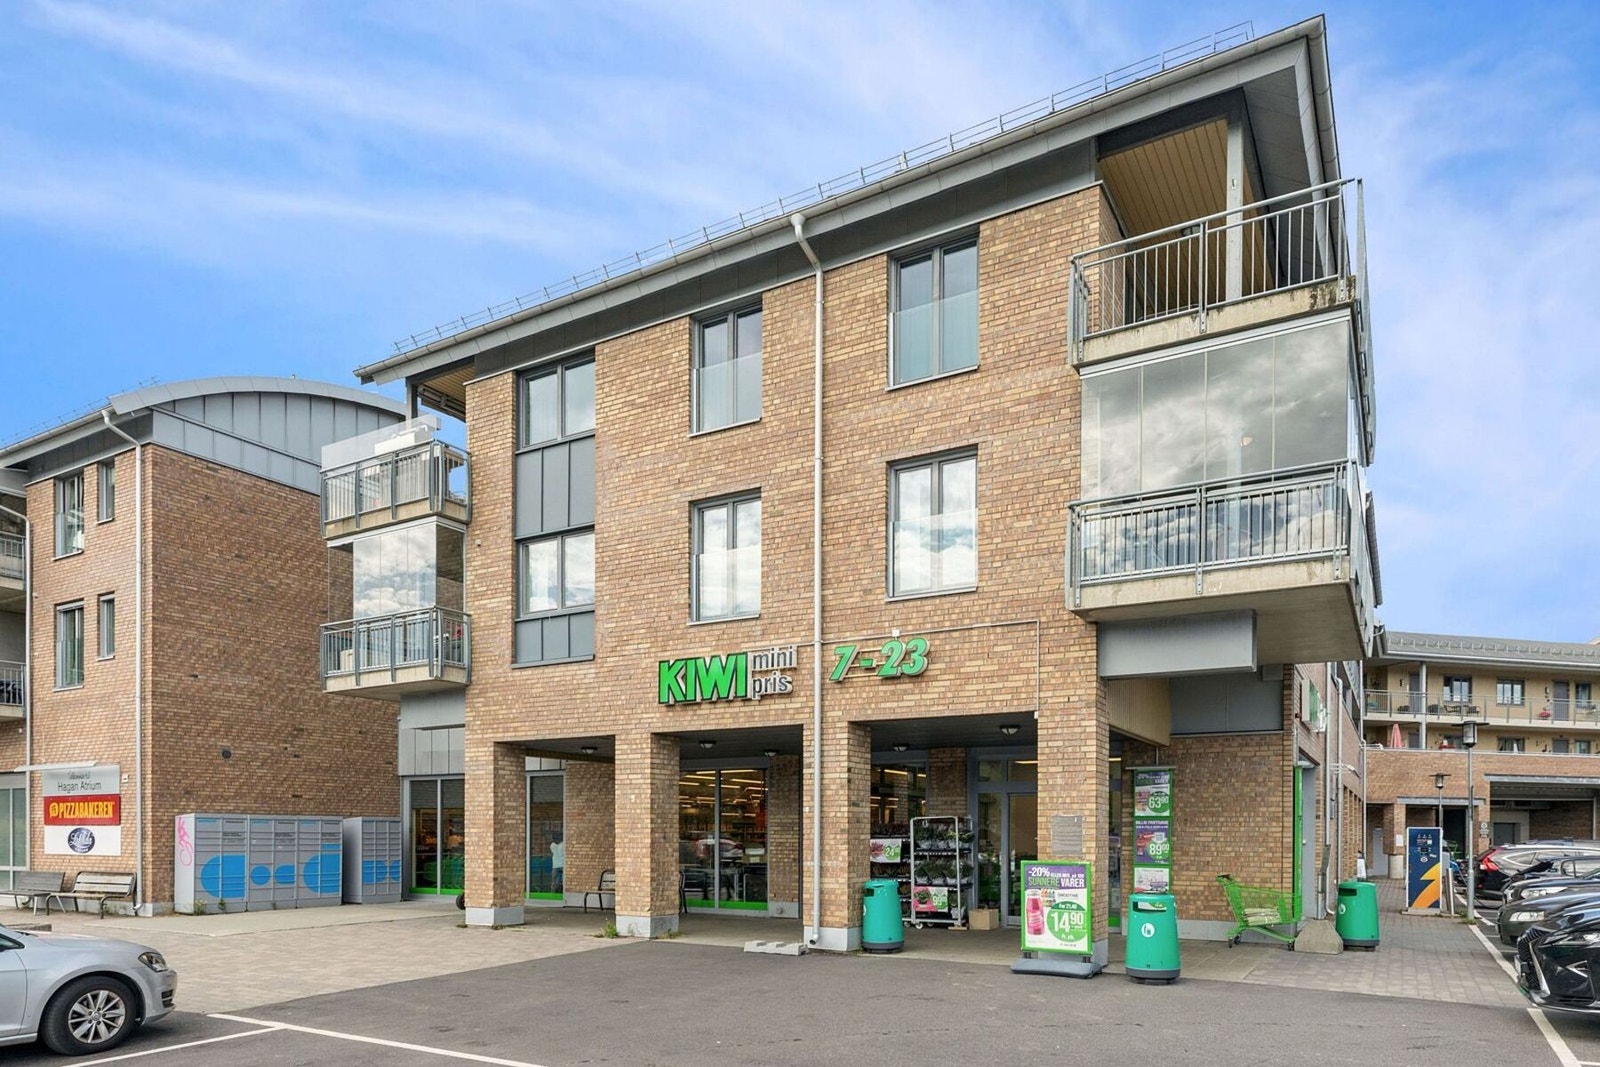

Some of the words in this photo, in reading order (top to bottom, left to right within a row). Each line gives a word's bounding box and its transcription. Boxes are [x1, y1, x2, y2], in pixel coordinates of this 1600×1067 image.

[752, 646, 797, 671] mini
[829, 637, 931, 682] 7-23
[658, 651, 749, 705] KIWI
[752, 672, 792, 700] pris
[57, 782, 79, 793] Hagan
[80, 780, 102, 791] Atrium
[58, 801, 113, 819] PIZZABAKEREN
[1028, 866, 1051, 878] -20%
[1060, 878, 1085, 888] VARER
